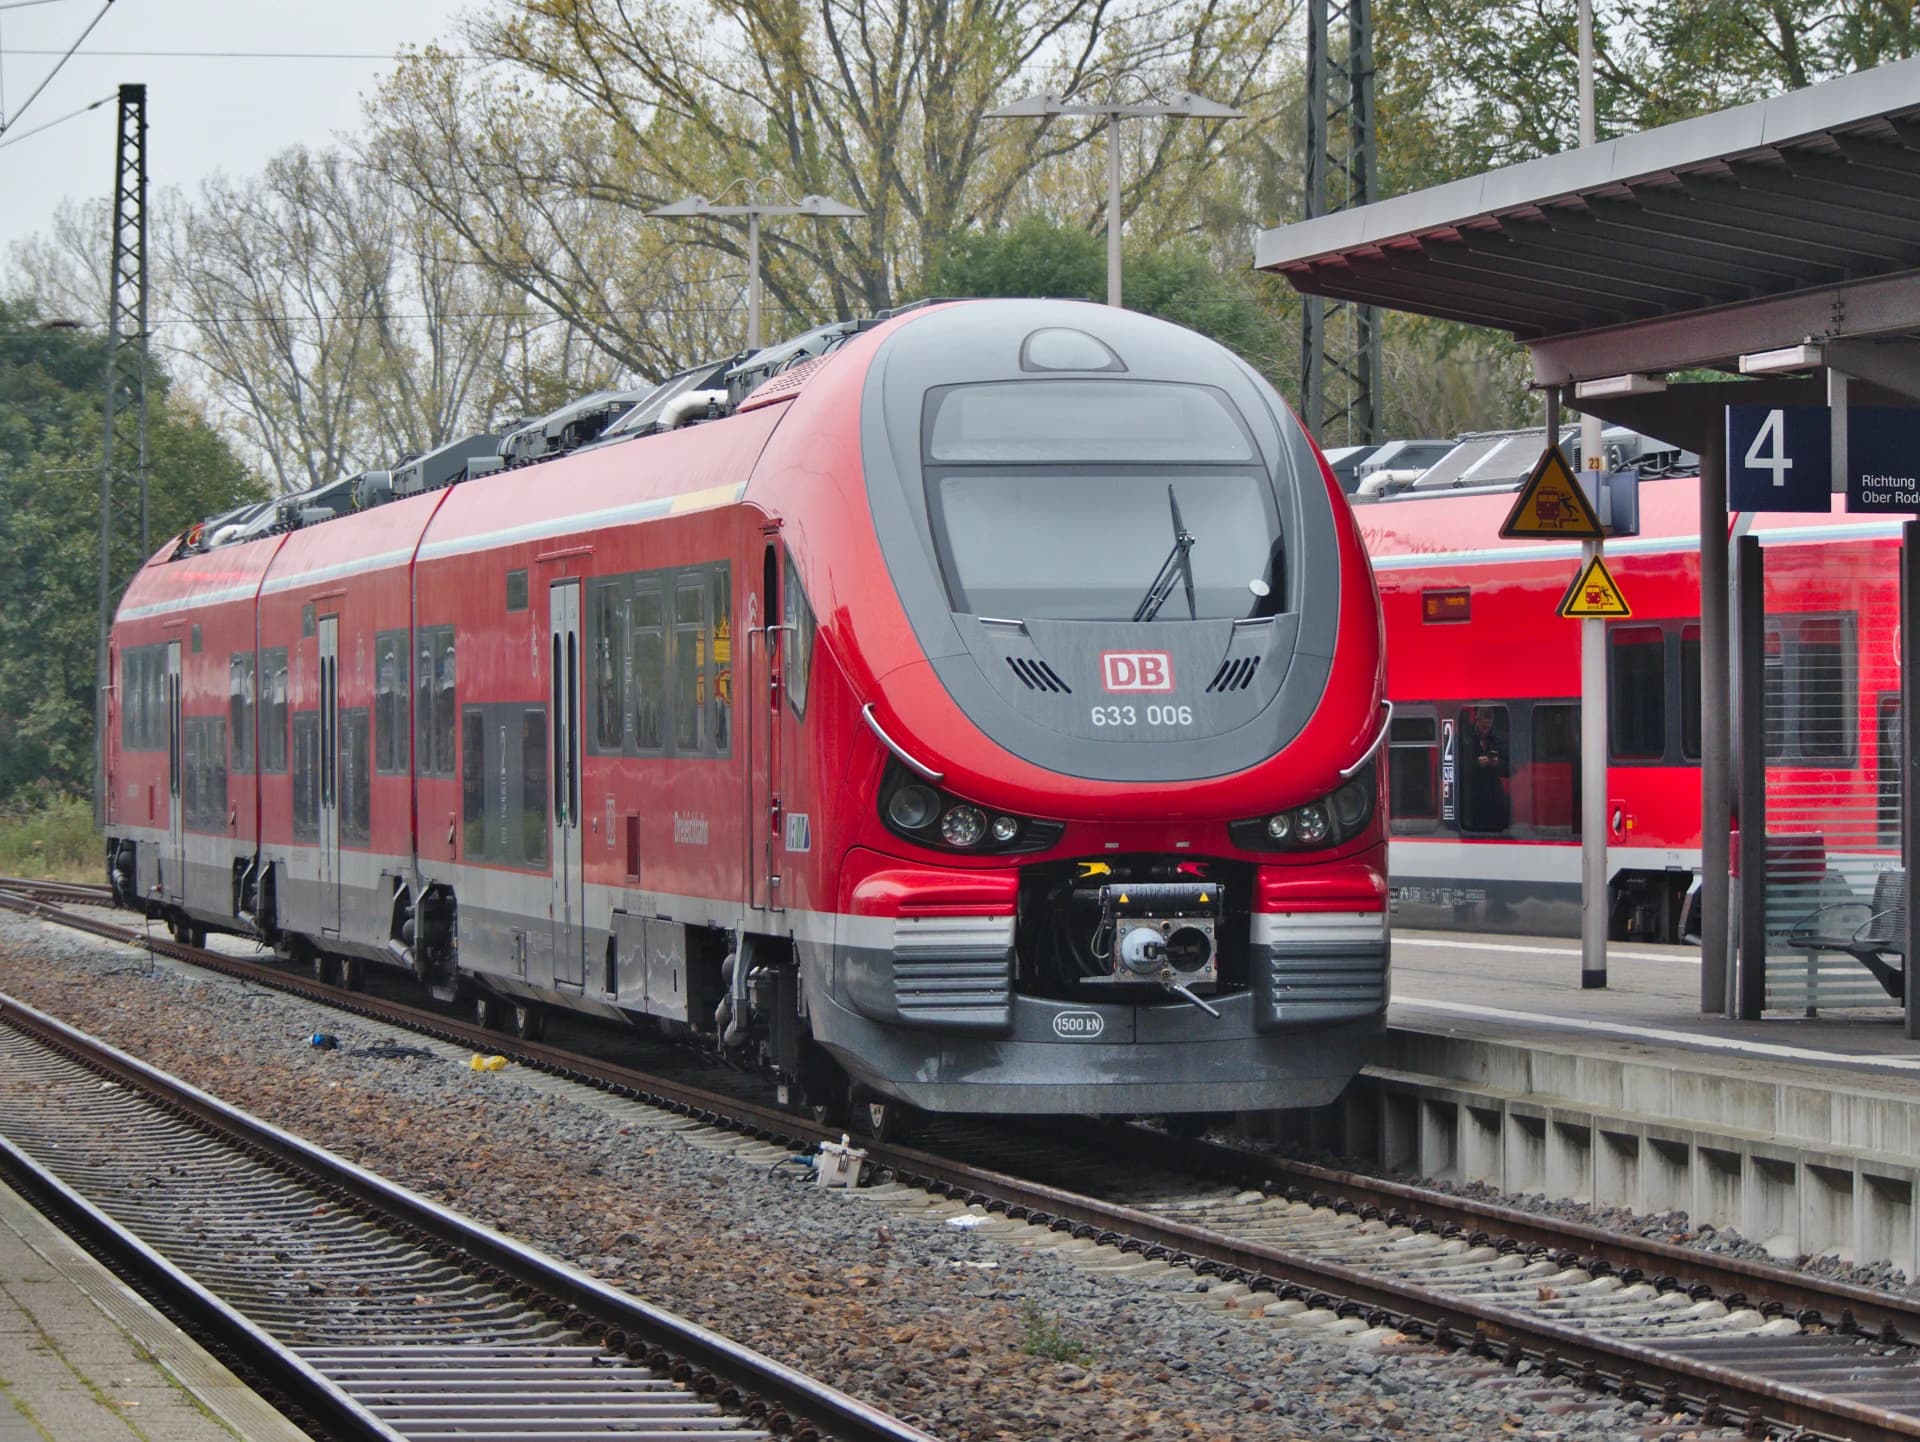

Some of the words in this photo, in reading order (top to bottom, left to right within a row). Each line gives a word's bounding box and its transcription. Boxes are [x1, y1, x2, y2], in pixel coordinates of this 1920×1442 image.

[1744, 409, 1793, 487] 4
[1589, 457, 1600, 470] 23
[1862, 474, 1916, 490] Richtung
[1862, 490, 1892, 504] Ober
[1895, 491, 1920, 504] Rod
[1109, 657, 1165, 686] DB
[1091, 706, 1137, 726] 633
[1147, 705, 1192, 726] 006
[1444, 722, 1453, 761] 2
[1056, 1018, 1084, 1031] 1500
[1086, 1018, 1100, 1031] kN
